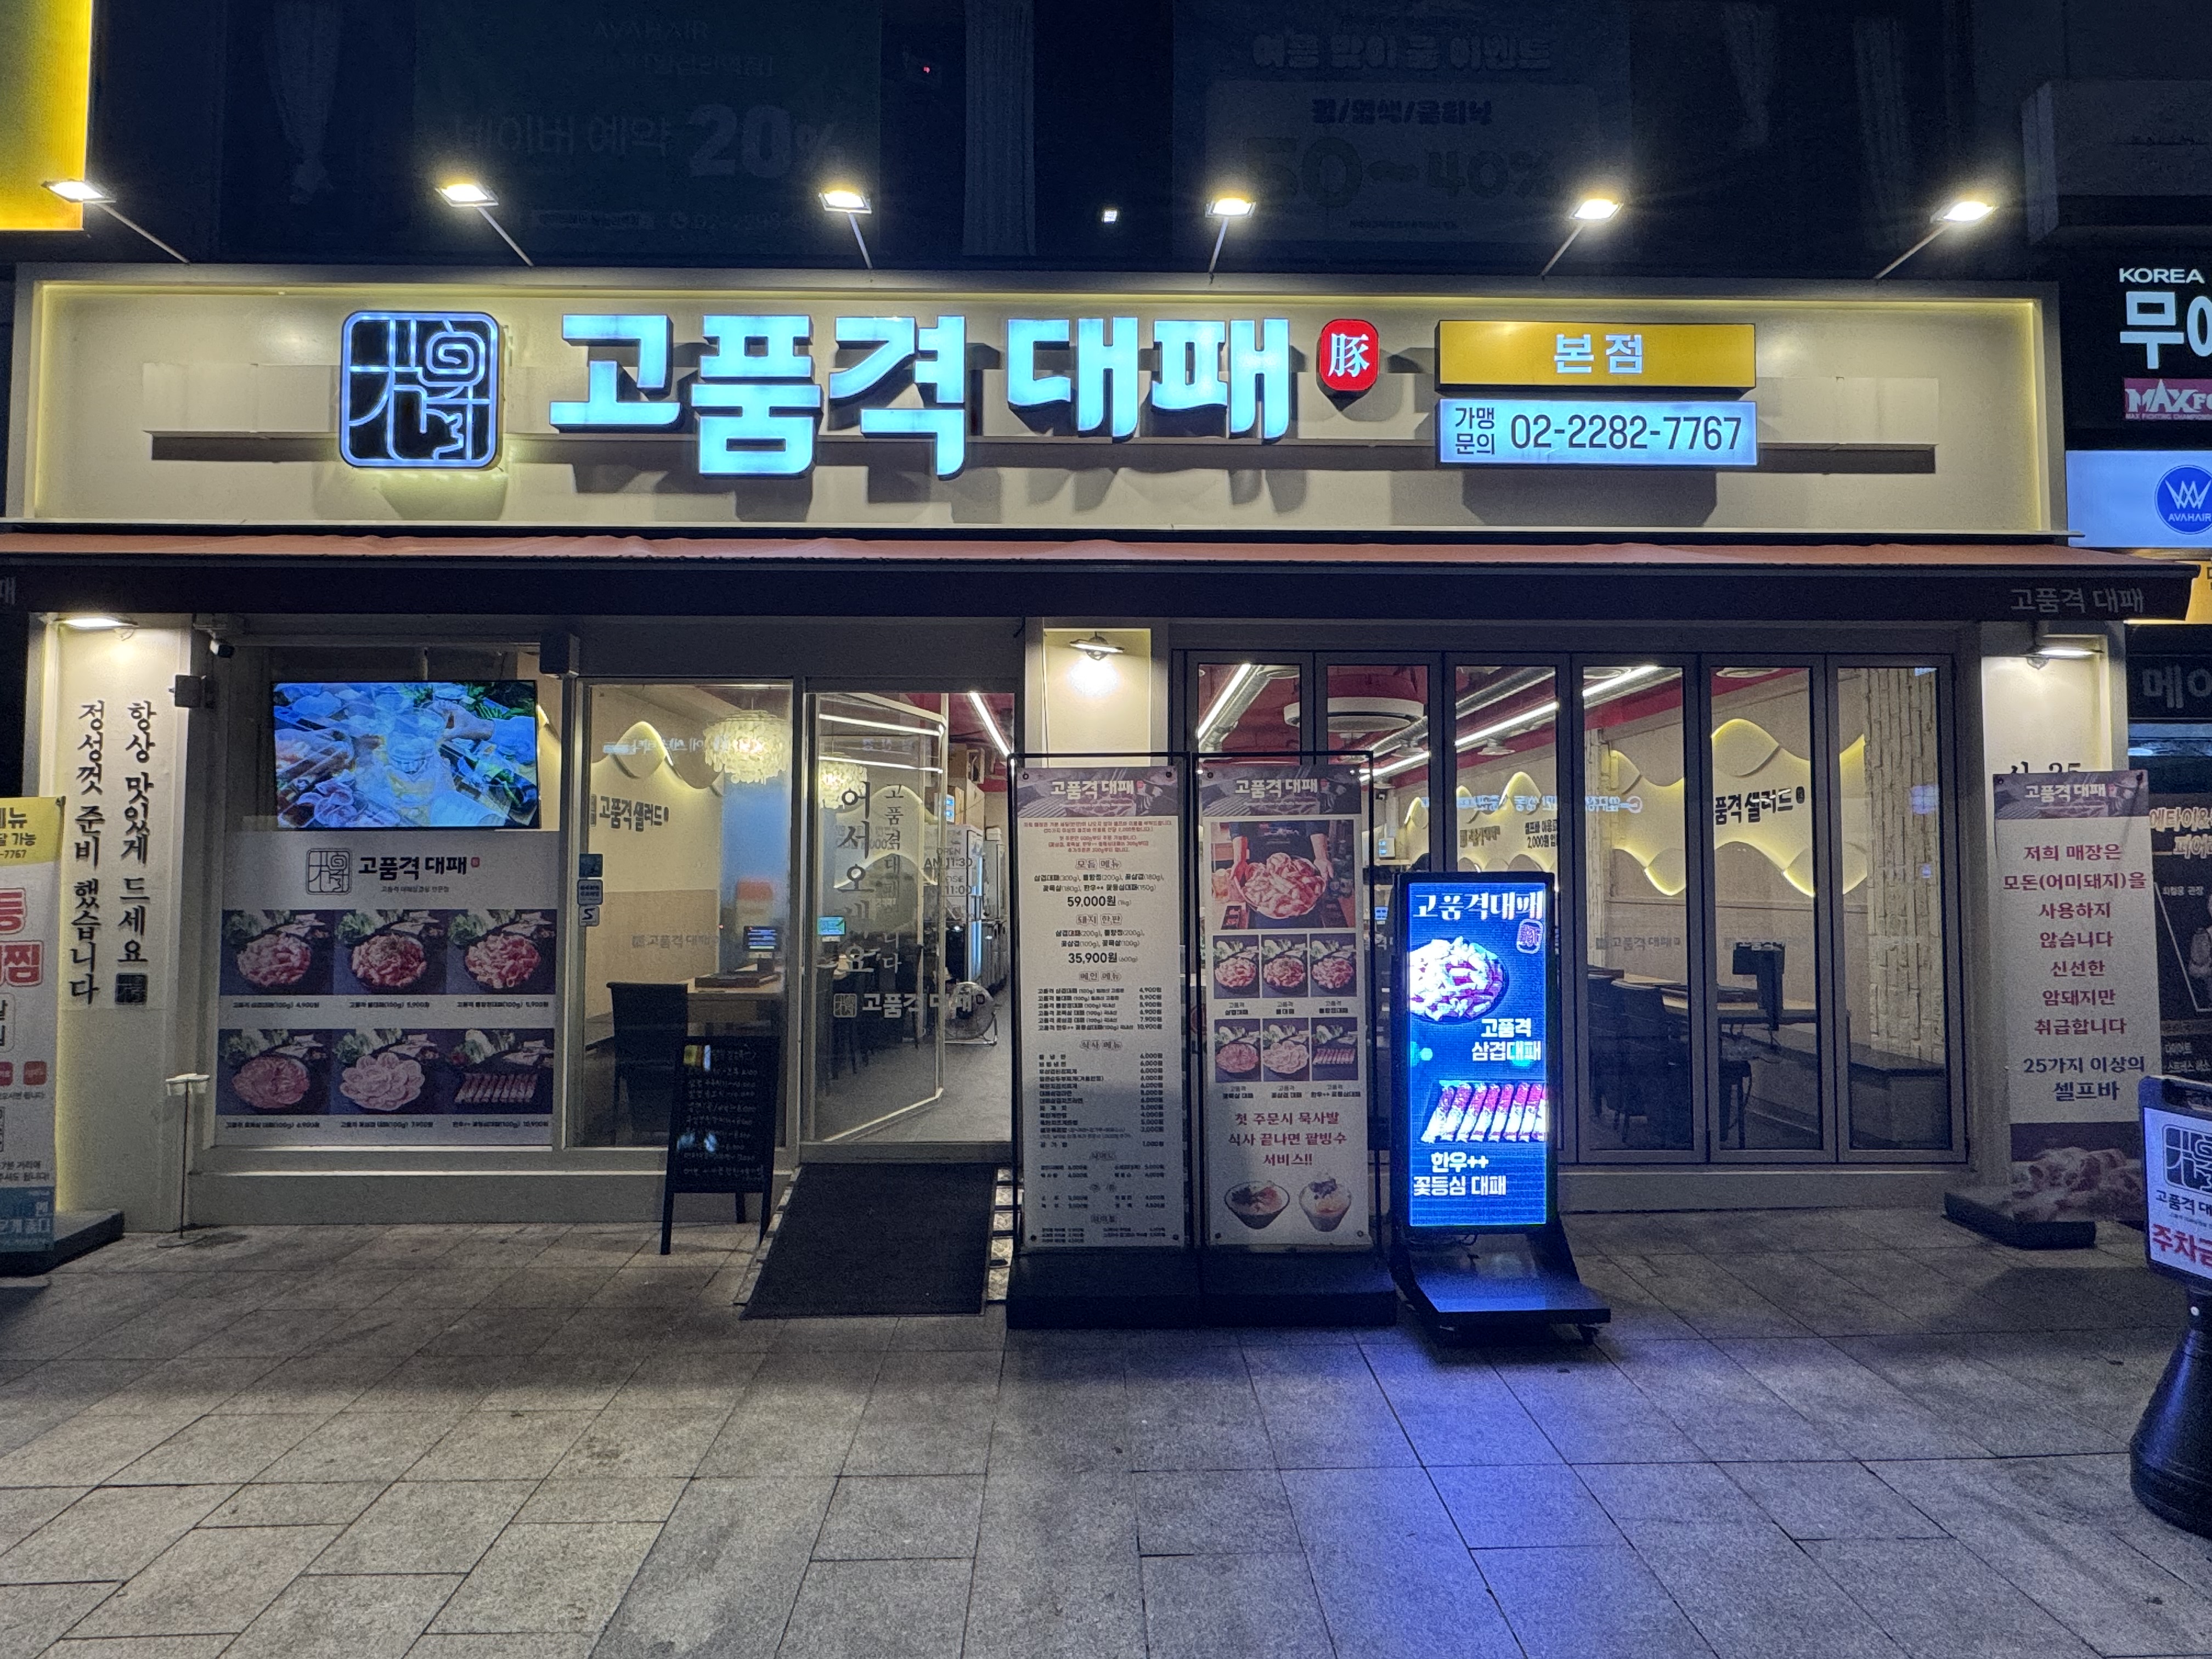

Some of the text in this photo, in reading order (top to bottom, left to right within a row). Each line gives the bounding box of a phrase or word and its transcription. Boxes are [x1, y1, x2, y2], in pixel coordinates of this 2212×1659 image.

[2119, 268, 2205, 283] KOREA
[1327, 331, 1371, 379] 豚
[1554, 333, 1644, 375] 본점
[550, 314, 1289, 479] 고품격 대패
[1454, 407, 1496, 429] 가맹
[1510, 414, 1742, 451] 02-2282-7767
[1454, 433, 1496, 455] 문의
[2168, 514, 2212, 522] AVAHAIR
[2010, 588, 2144, 613] 고품격 대패
[1050, 780, 1135, 800] 고품격 대패
[1235, 778, 1318, 799] 고품격 대패
[2025, 783, 2106, 803] 고품격 대패
[599, 795, 632, 831] 고품격
[1714, 794, 1742, 825] 품격
[12, 833, 37, 846] 가능
[117, 700, 157, 963] 항상 맛있게 드세요
[69, 699, 106, 1005] 정성껏 준비 했습니다
[2023, 844, 2123, 862] 저희 매장은
[358, 856, 467, 881] 고품격 대패
[1099, 858, 1122, 870] 메뉴
[2003, 871, 2147, 891] 모돈(어미돼지)을
[1067, 896, 1116, 907] 59,000원
[1413, 890, 1544, 921] 고품격대패
[2039, 901, 2111, 919] 사용하지
[2040, 931, 2114, 949] 않습니다
[1068, 952, 1118, 964] 35,900원
[1101, 971, 1121, 981] 메뉴
[2050, 960, 2106, 977] 신선한
[2042, 989, 2116, 1007] 암돼지만
[1481, 1018, 1532, 1038] 고품격
[2034, 1018, 2128, 1036] 취급합니다
[1471, 1040, 1542, 1062] 삼겹대패
[2023, 1056, 2145, 1074] 25가지 이상의
[2053, 1081, 2120, 1102] 셀프바
[1235, 1111, 1340, 1125] 첫 주문시 묵사발
[1228, 1133, 1256, 1147] 식사
[1260, 1133, 1300, 1146] 끝나면
[1263, 1153, 1313, 1166] 서비스!!
[1431, 1152, 1489, 1173] 한우++
[1413, 1175, 1507, 1197] 꽃등심 대패
[2155, 1189, 2195, 1216] 고품격
